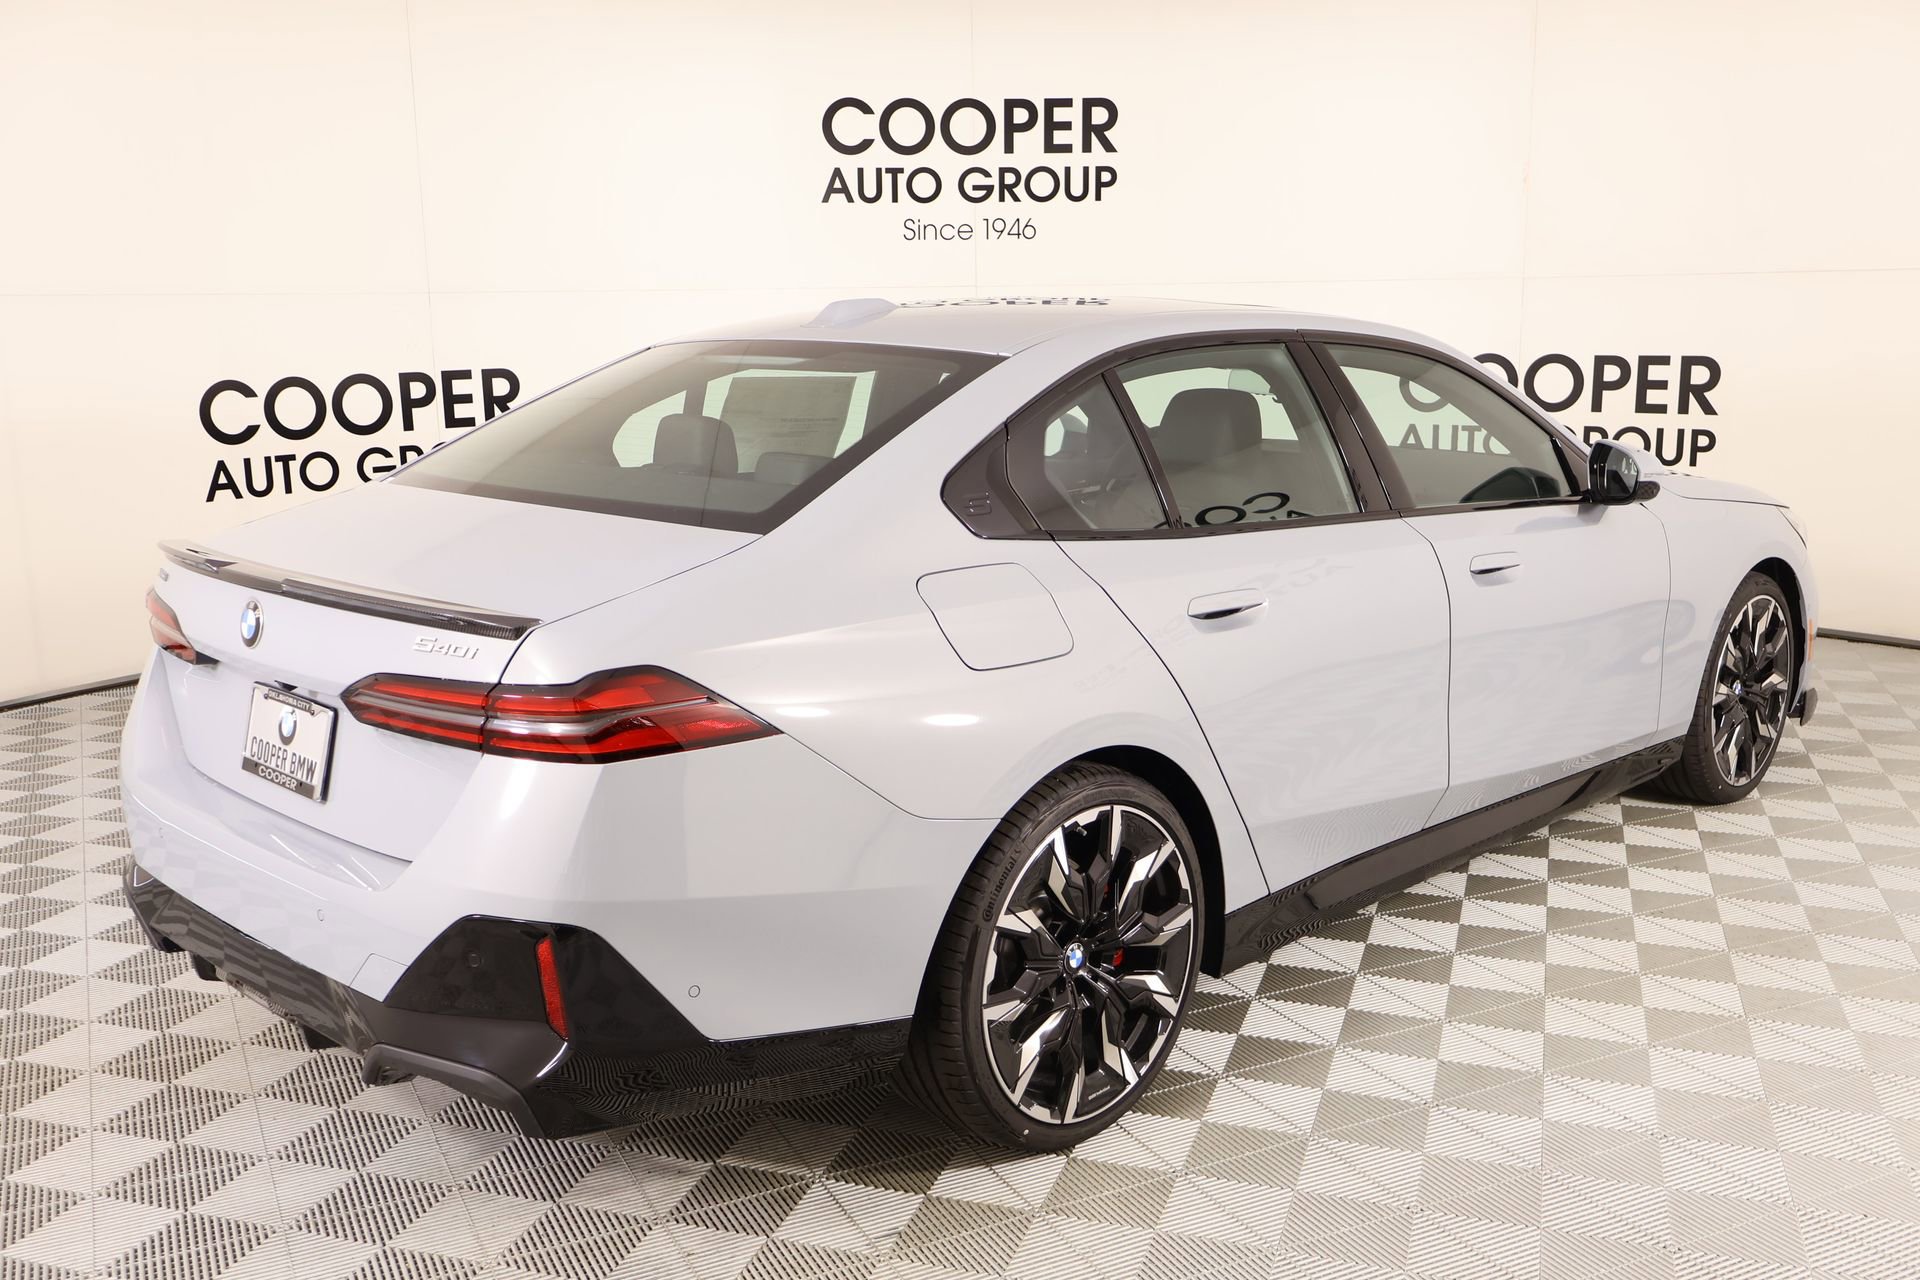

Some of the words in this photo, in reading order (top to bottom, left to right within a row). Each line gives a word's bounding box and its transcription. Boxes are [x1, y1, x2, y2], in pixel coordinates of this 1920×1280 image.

[822, 97, 1119, 156] COOPER
[821, 167, 942, 204] AUTO
[958, 166, 1118, 203] GROUP
[903, 218, 973, 241] Since
[983, 217, 1037, 240] 1946
[199, 368, 521, 446] COOPER
[1563, 425, 1717, 468] ROUP
[205, 450, 340, 503] AUTO
[250, 736, 288, 771] COOPER
[289, 752, 317, 783] BMW
[259, 765, 297, 791] COOPER
[983, 856, 1018, 922] Continental
